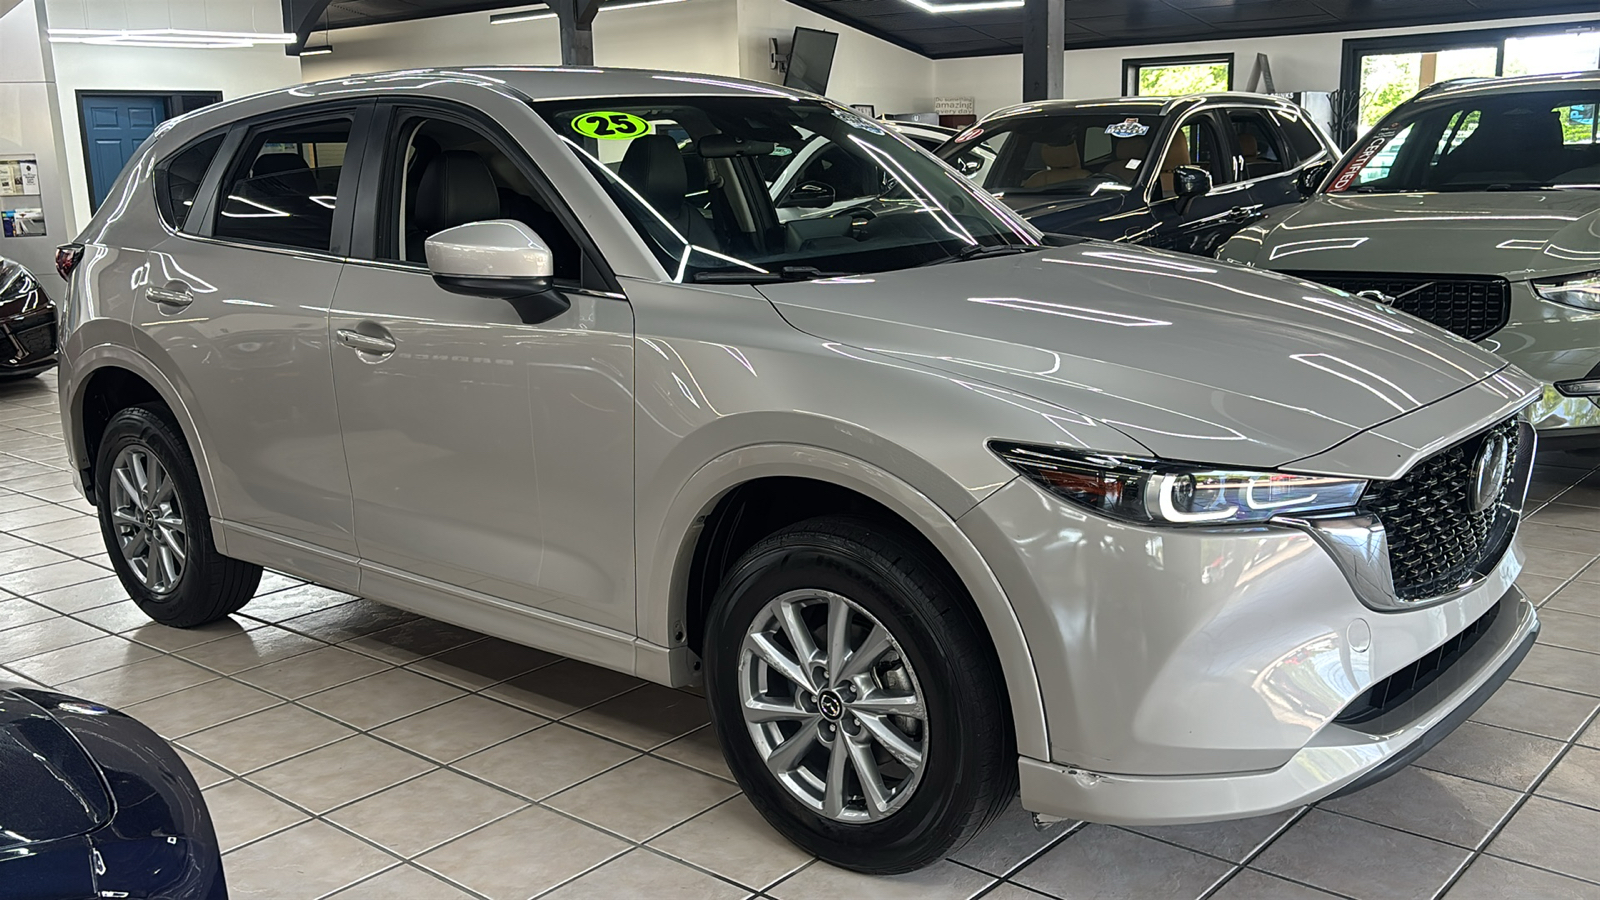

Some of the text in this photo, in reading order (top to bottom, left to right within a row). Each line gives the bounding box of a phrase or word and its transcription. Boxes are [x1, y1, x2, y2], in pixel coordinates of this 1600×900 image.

[935, 101, 973, 109] amazing
[586, 114, 637, 135] 25
[1334, 137, 1385, 189] CERTIFIED
